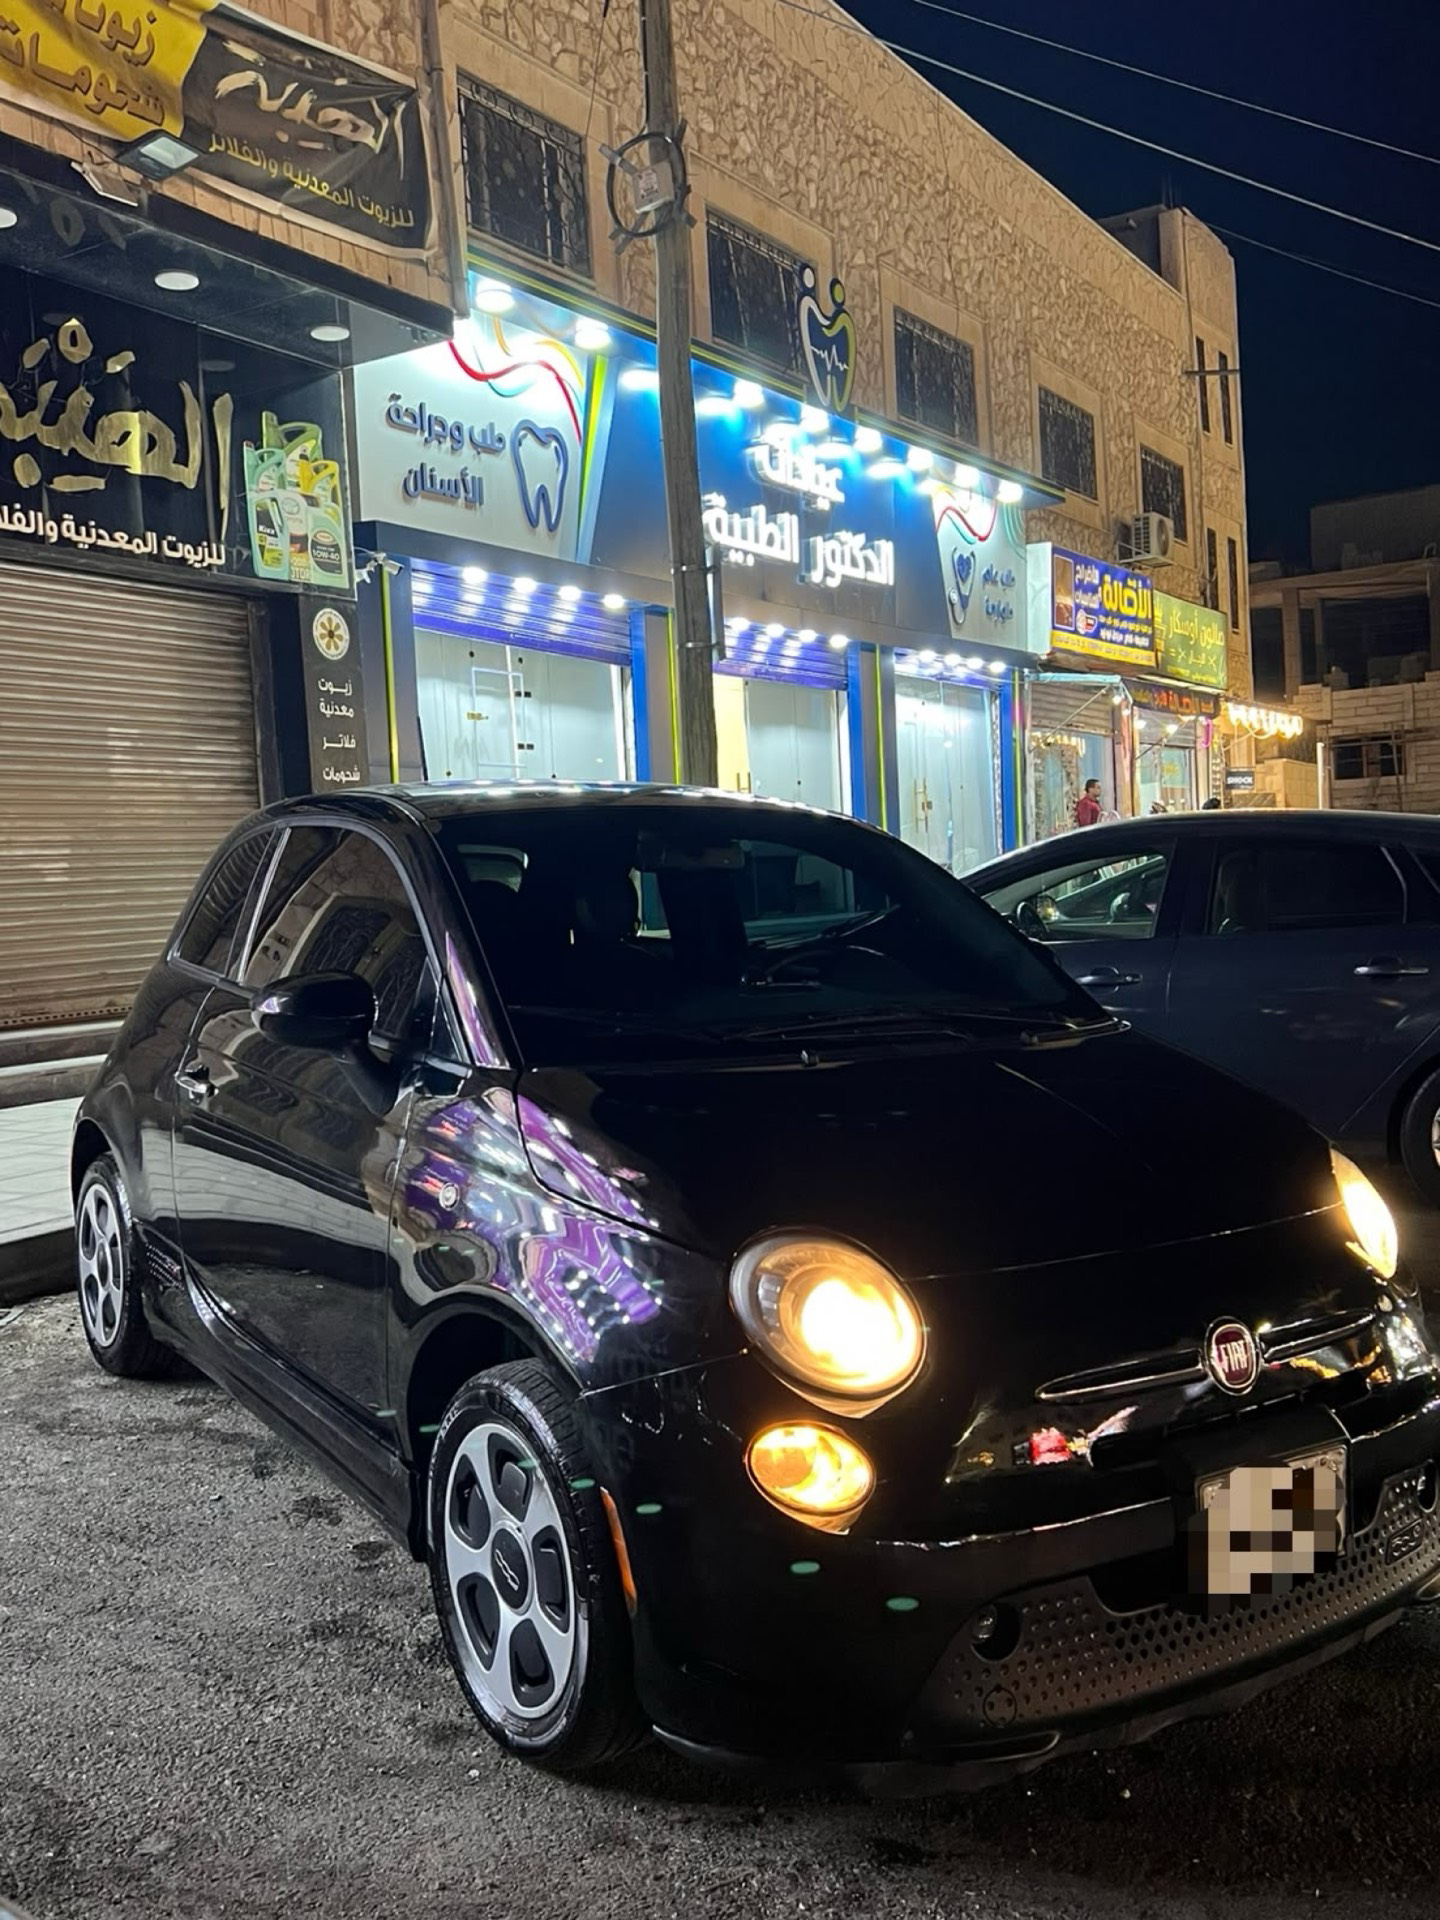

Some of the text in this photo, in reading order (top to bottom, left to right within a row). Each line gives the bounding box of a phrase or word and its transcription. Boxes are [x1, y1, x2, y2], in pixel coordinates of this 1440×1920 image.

[282, 156, 355, 207] المعدنية
[385, 393, 507, 456] طب وجراحة
[402, 462, 484, 506] الأسنان
[61, 512, 157, 554] المعدنية
[702, 491, 894, 587] الدكتور الطبية
[162, 535, 225, 568] للزيوت
[318, 678, 352, 696] زيوت
[319, 698, 354, 718] معدنية
[322, 734, 356, 750] فلاتر
[322, 764, 361, 783] شحومات
[1219, 1340, 1248, 1373] FIAT
